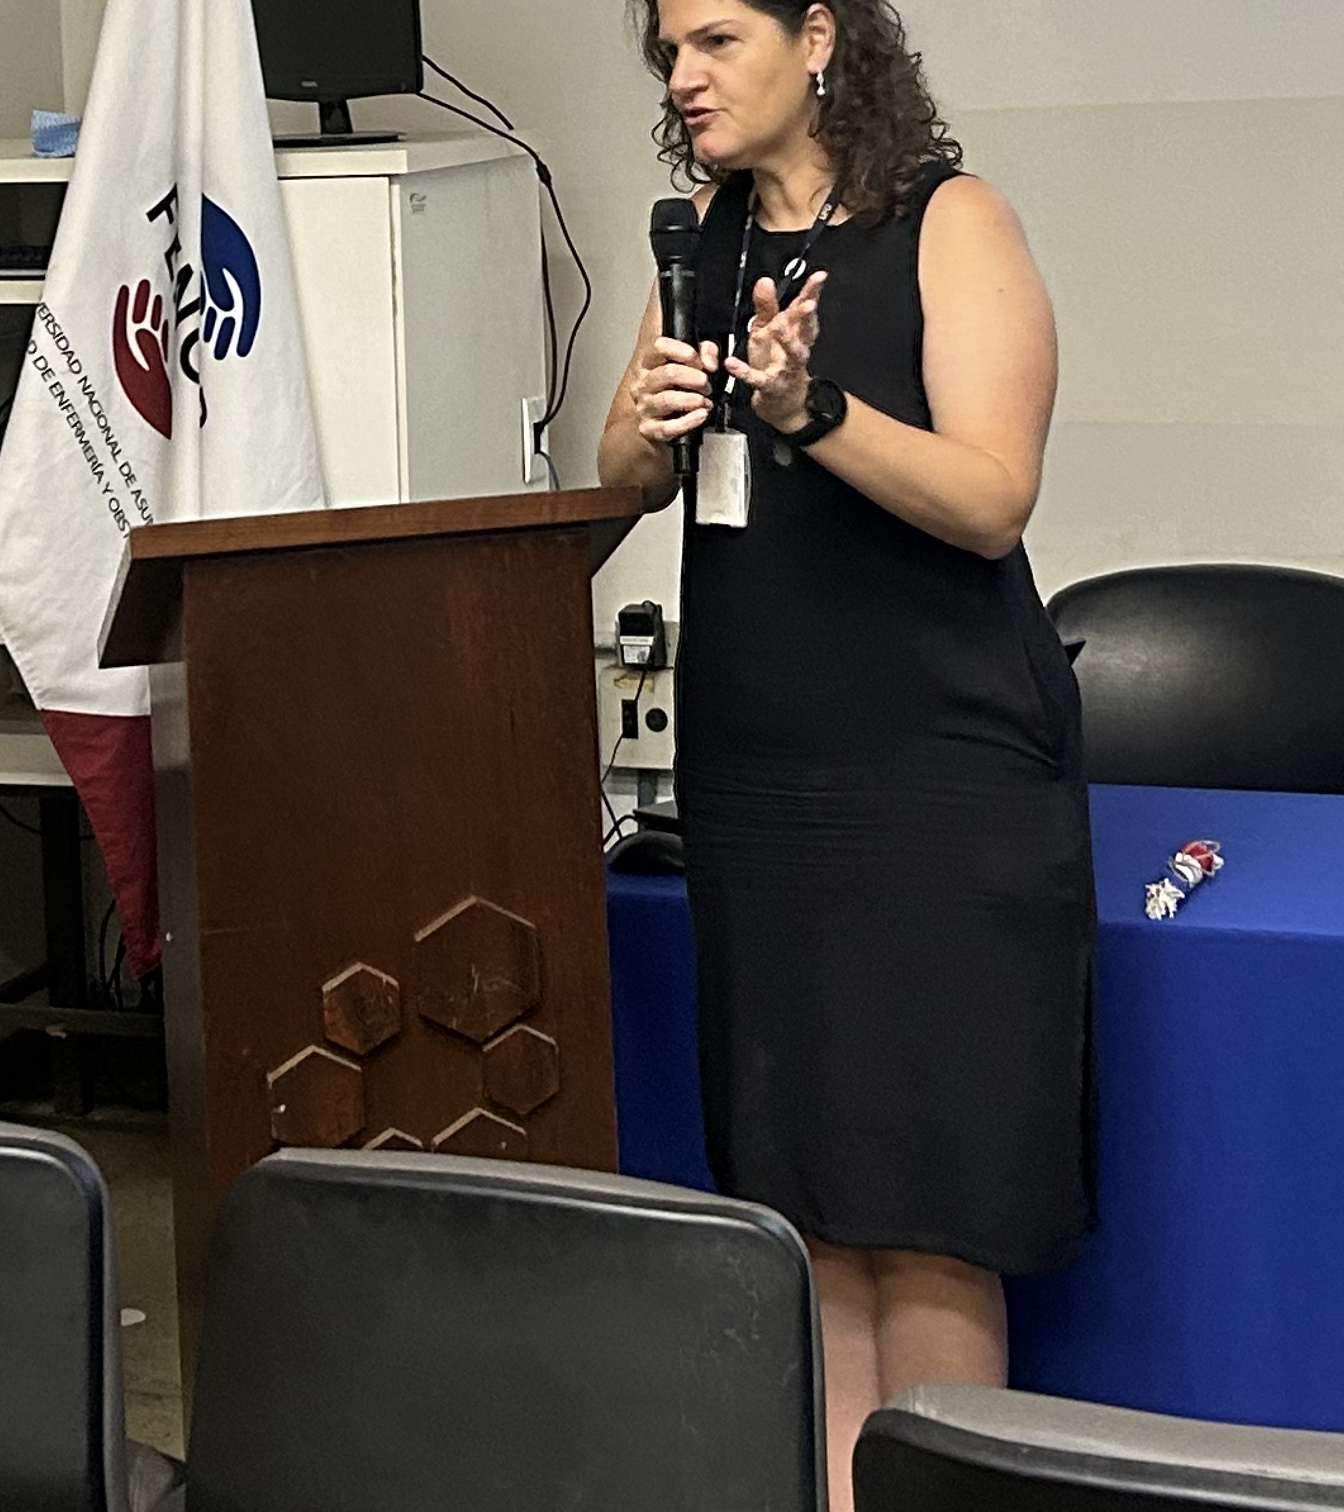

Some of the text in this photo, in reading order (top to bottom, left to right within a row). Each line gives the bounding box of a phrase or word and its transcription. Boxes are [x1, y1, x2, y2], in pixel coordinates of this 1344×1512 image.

[33, 355, 56, 383] DE
[49, 381, 104, 485] ENFERMERÍA
[102, 482, 114, 496] Y
[77, 375, 122, 464] NACIONAL
[118, 461, 137, 486] DE
